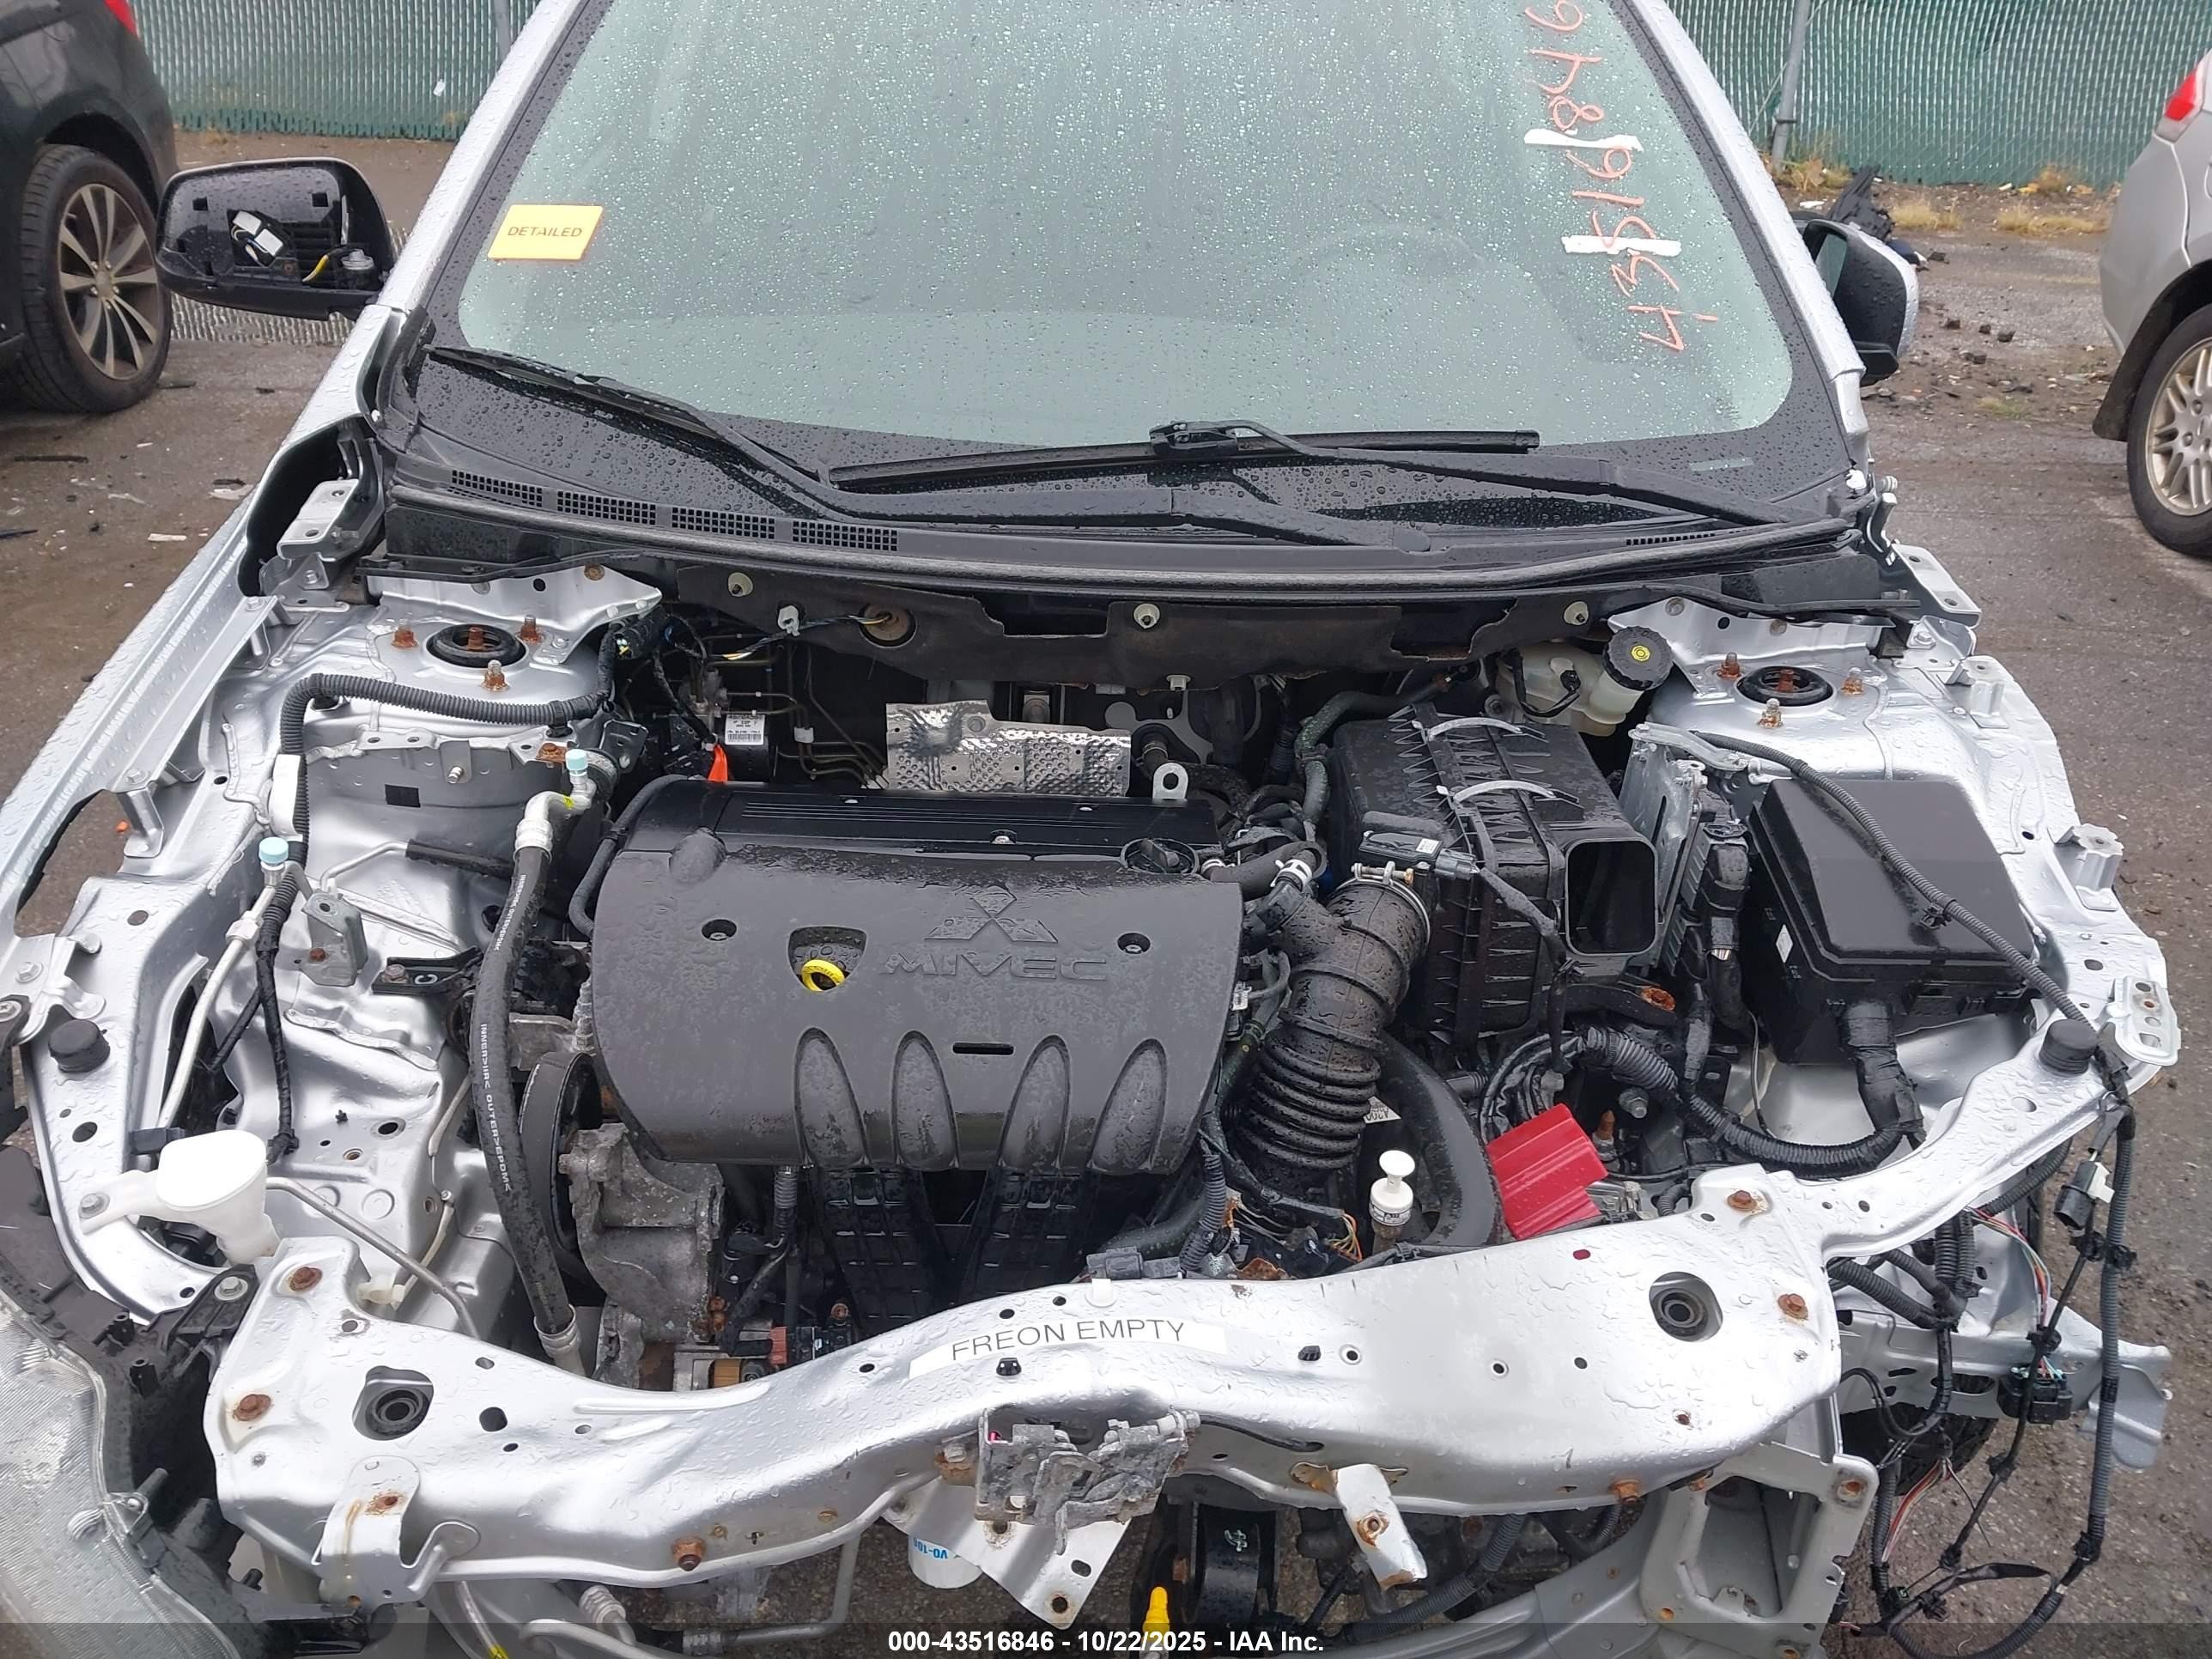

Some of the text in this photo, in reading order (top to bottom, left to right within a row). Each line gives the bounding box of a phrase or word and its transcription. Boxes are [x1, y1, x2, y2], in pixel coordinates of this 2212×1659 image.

[1525, 0, 1717, 350] 43516846
[507, 226, 583, 237] DETAILED
[878, 952, 1107, 981] MIVEC
[951, 1319, 1184, 1361] FREON EMPTY
